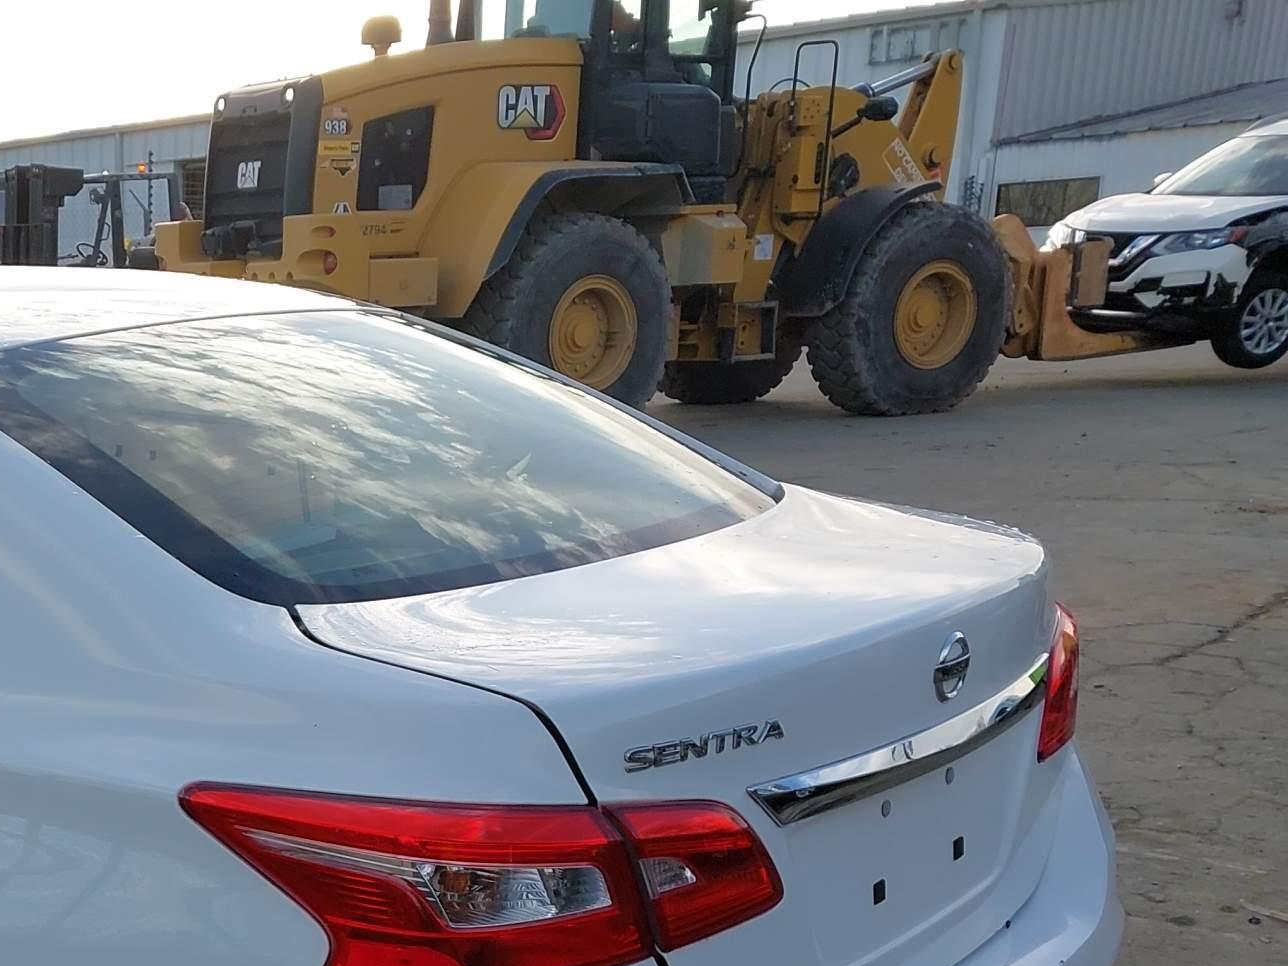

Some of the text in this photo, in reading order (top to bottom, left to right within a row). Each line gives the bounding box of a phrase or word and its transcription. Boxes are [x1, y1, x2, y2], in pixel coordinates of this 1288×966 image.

[498, 85, 551, 128] CAT
[324, 119, 348, 134] 938
[237, 160, 262, 189] CAT
[623, 718, 785, 774] SENTRA
